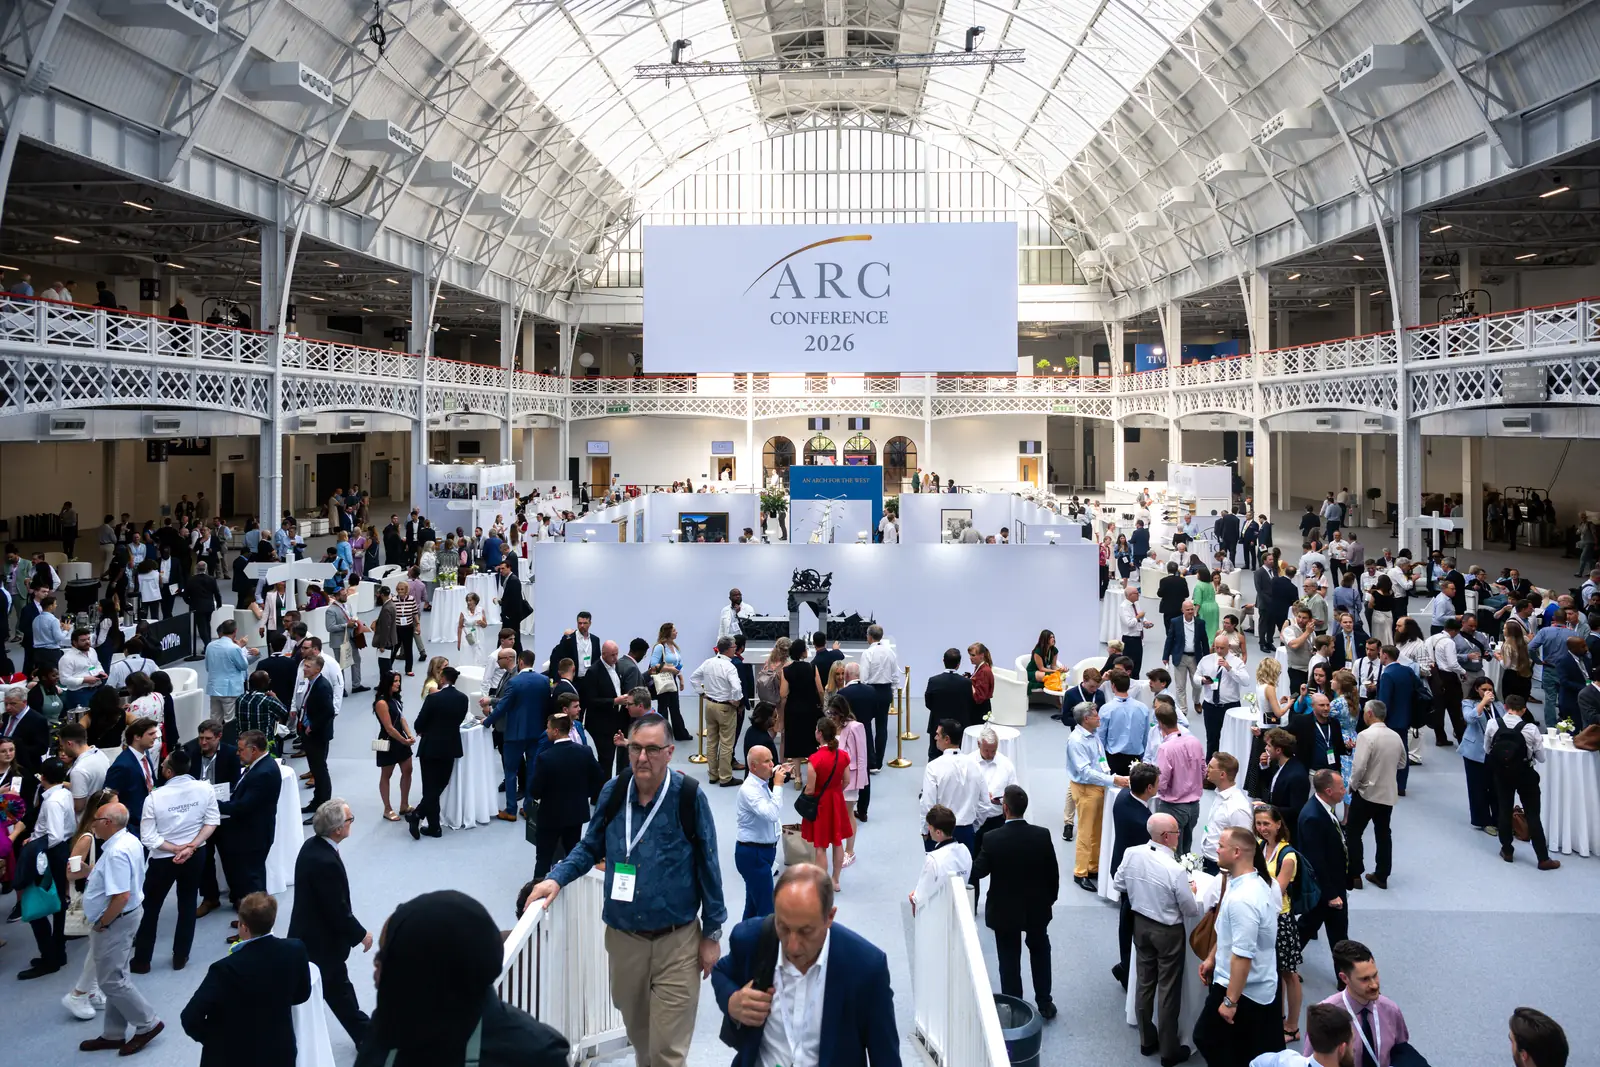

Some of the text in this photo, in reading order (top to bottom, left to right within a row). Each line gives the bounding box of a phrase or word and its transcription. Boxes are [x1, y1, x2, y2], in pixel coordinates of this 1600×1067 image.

[769, 261, 890, 299] ARC
[770, 310, 889, 325] CONFERENCE
[804, 333, 855, 352] 2026
[1146, 355, 1166, 364] TIM
[167, 801, 199, 812] CONFERENCE
